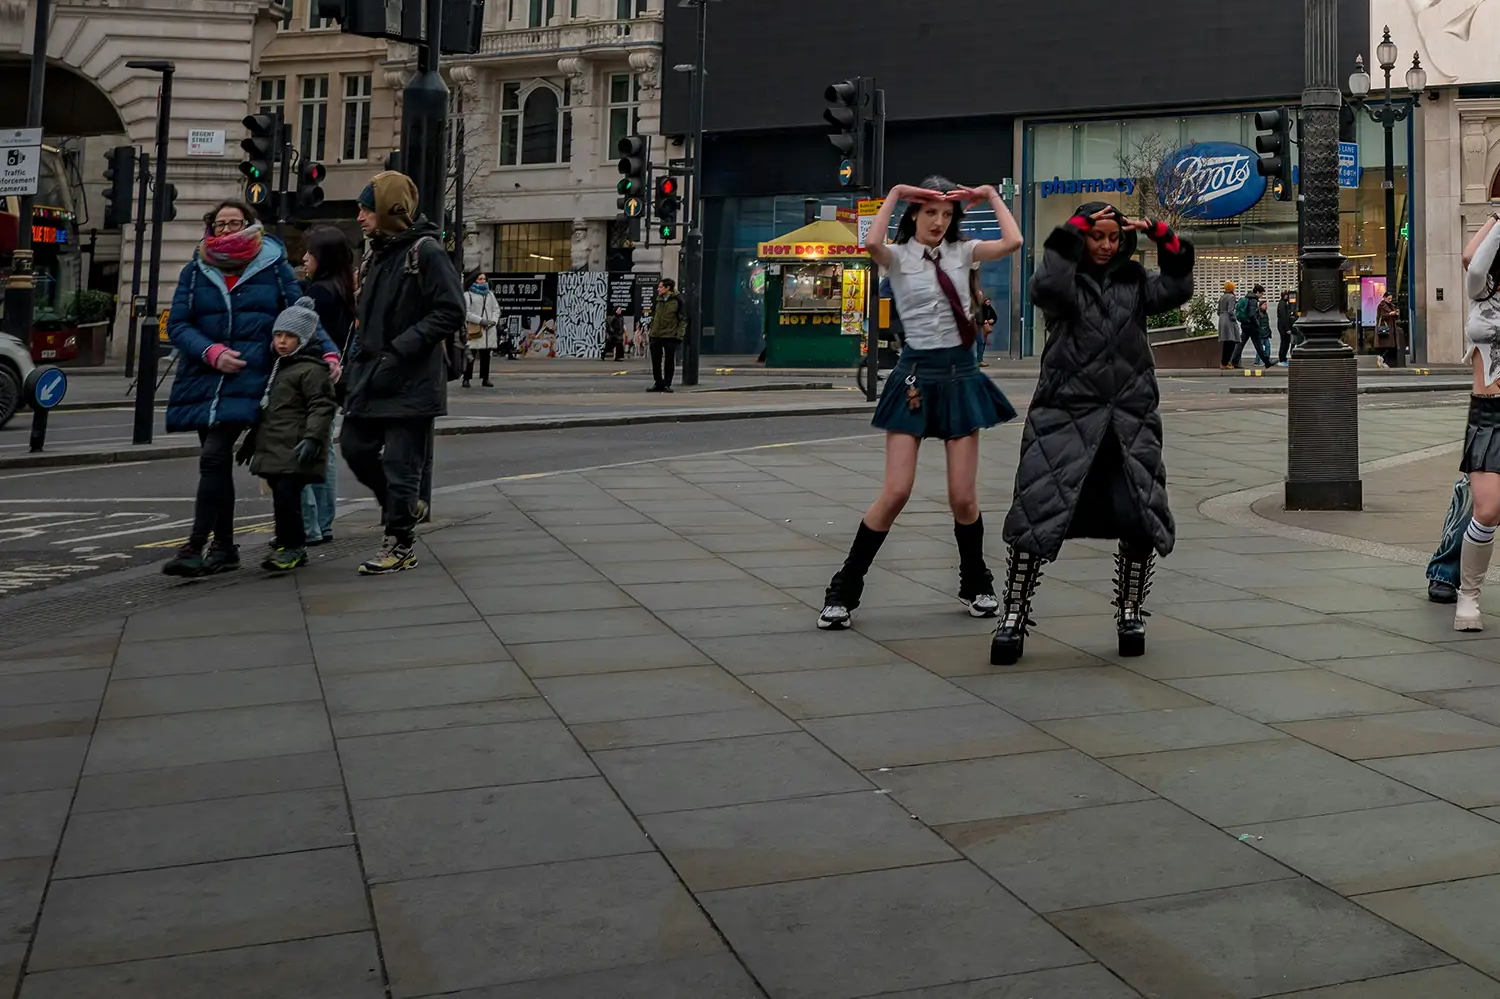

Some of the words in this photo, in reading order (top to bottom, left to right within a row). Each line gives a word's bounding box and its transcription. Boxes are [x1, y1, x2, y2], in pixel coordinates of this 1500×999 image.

[1174, 153, 1251, 205] Boots
[1040, 176, 1137, 199] pharmacy
[763, 245, 792, 255] HOT
[795, 245, 824, 255] DOG
[779, 315, 807, 325] HOT
